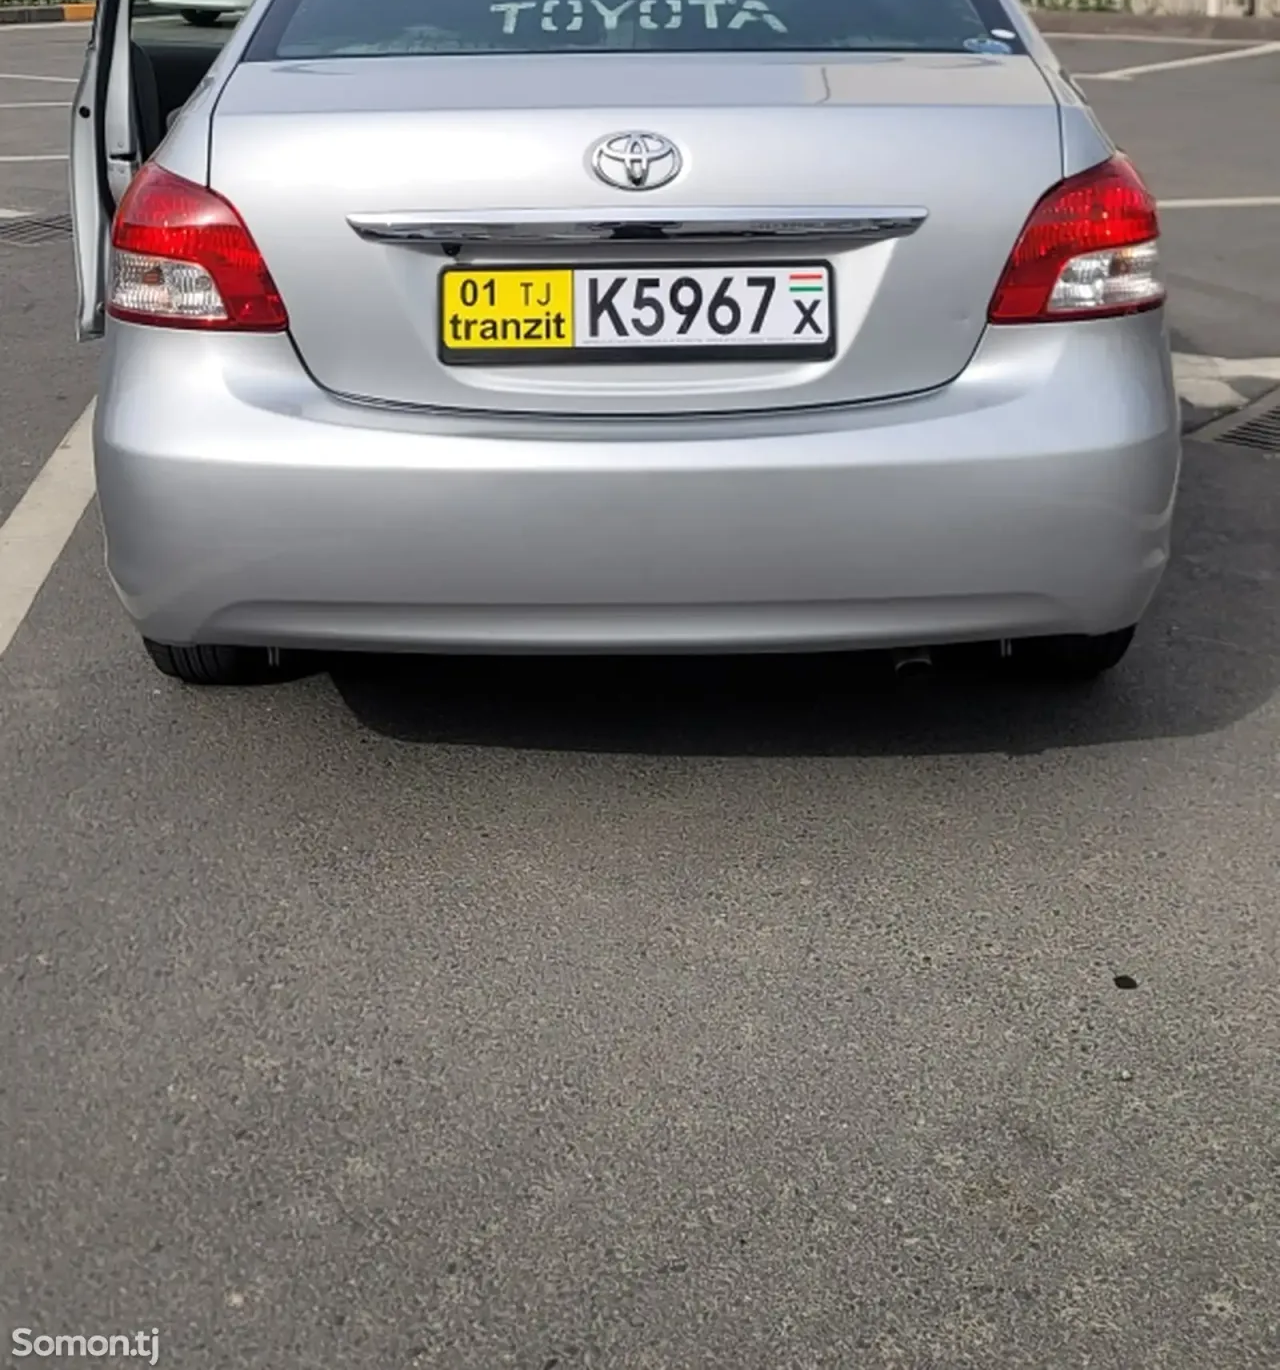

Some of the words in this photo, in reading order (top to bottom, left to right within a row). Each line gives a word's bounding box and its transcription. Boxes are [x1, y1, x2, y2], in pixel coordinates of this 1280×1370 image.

[460, 278, 496, 307] 01
[520, 282, 552, 307] TJ
[588, 276, 776, 337] K5967
[450, 312, 565, 341] tranzit
